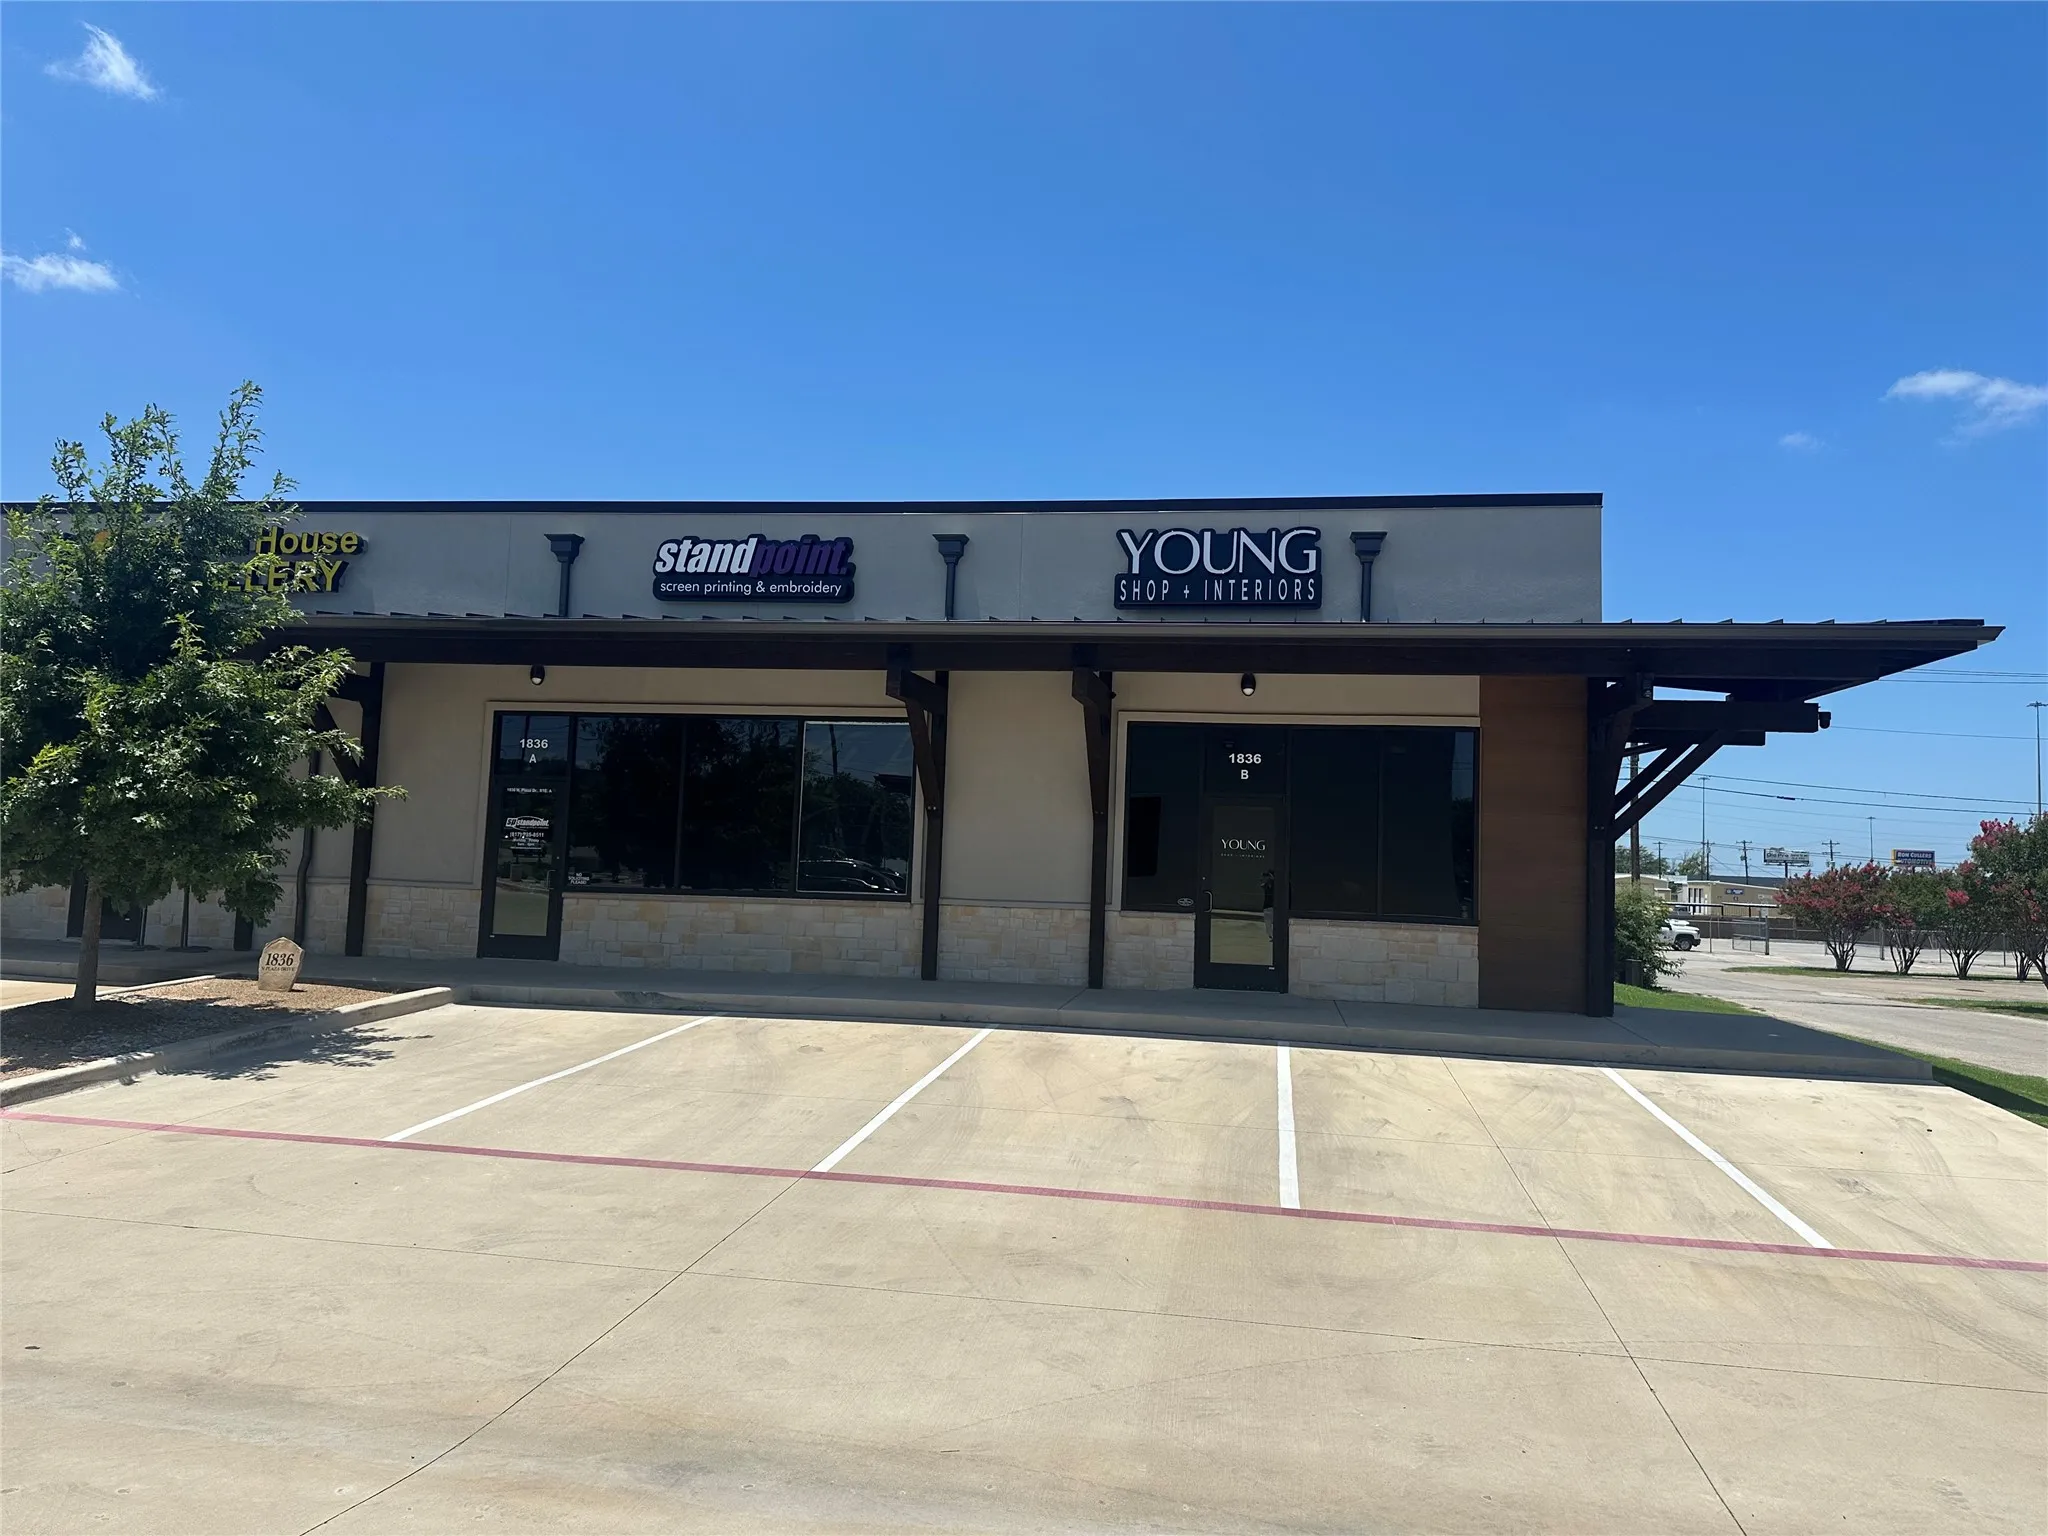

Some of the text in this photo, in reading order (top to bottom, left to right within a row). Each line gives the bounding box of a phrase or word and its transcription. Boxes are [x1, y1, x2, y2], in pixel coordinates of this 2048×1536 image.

[255, 526, 359, 554] House
[1120, 529, 1317, 575] YOUNG
[660, 580, 842, 596] screen printing & embroidery
[1119, 579, 1170, 601] SHOP
[1204, 578, 1315, 601] INTERIORS
[519, 738, 549, 749] 1836
[529, 753, 537, 764] A
[1228, 753, 1262, 764] 1836
[1240, 769, 1249, 780] B
[1221, 838, 1266, 851] YOUNG
[265, 953, 294, 966] 1836
